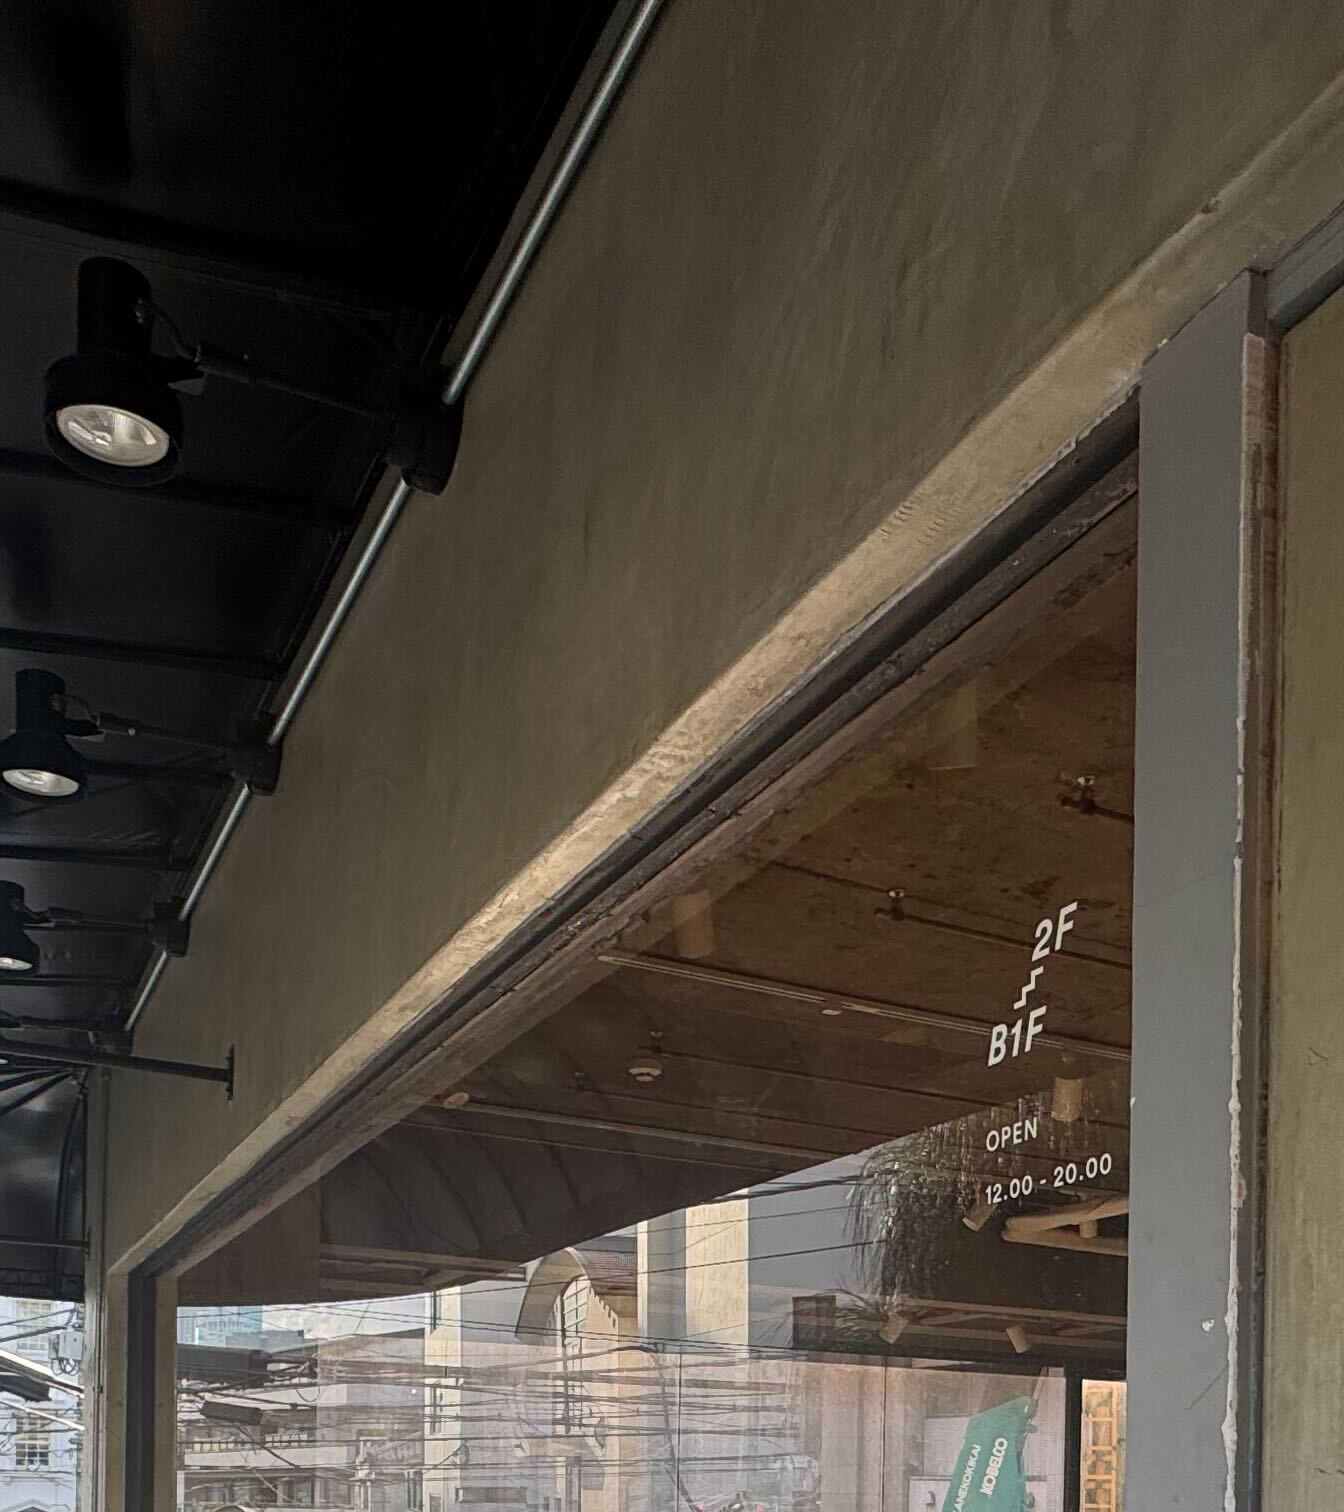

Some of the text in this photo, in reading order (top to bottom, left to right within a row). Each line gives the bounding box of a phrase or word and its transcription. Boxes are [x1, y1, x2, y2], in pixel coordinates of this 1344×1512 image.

[1031, 901, 1078, 962] 2F
[987, 1005, 1047, 1067] B1F
[985, 1116, 1038, 1152] OPEN
[984, 1174, 1033, 1205] 12.00
[1053, 1152, 1113, 1188] 20.00
[979, 1437, 1009, 1496] KOBELCO
